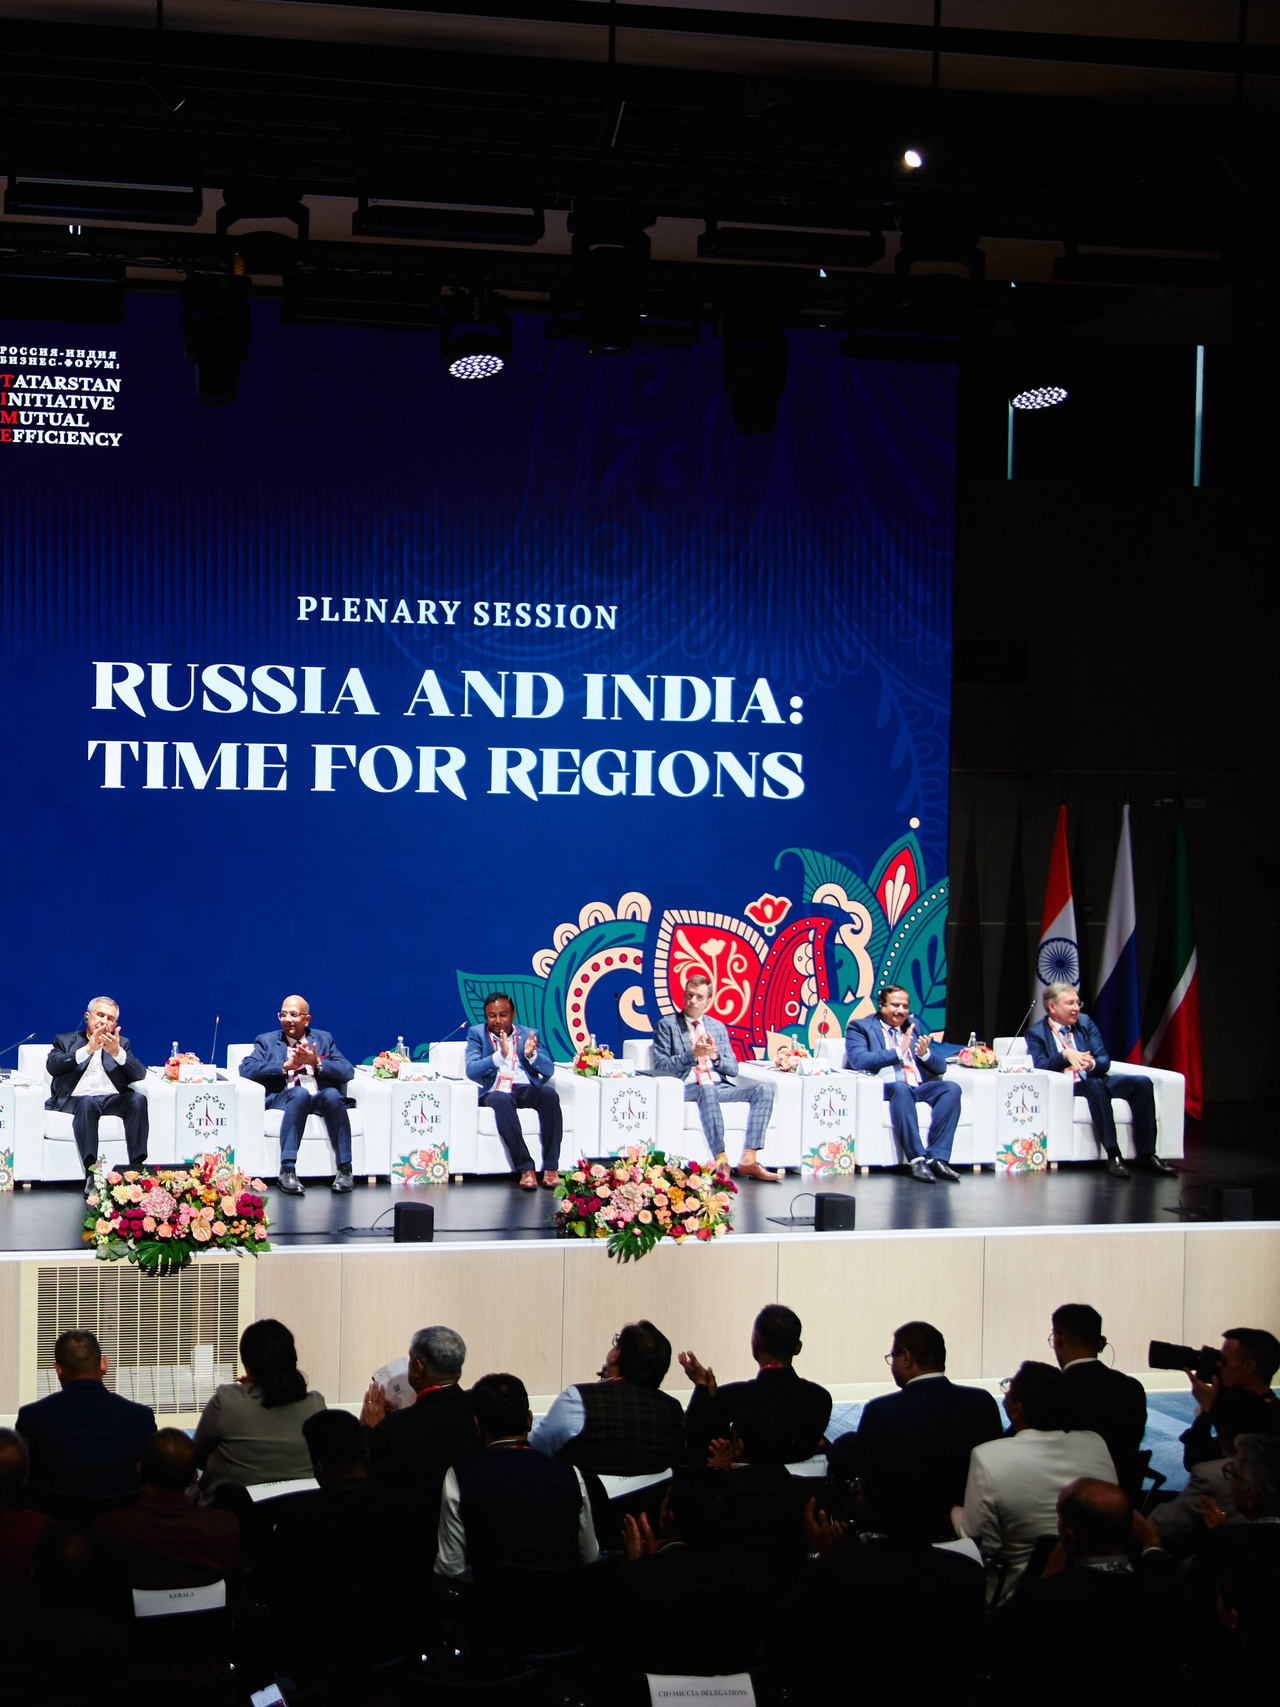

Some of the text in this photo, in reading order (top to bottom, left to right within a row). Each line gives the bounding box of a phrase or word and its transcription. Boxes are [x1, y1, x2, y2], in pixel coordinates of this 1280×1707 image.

[0, 346, 117, 360] РОССИЯ-ИНДИЯ
[0, 356, 120, 369] БИЗНЕС-ФОРУМ:
[0, 374, 122, 393] TATARSTAN
[0, 392, 115, 411] INITIATIVE
[0, 410, 90, 428] MUTUAL
[0, 428, 123, 447] EFFICIENCY
[297, 596, 618, 630] PLENARY SESSION
[91, 661, 804, 726] RUSSIA AND INDIA:
[87, 740, 806, 802] TIME FOR REGIONS
[620, 1111, 648, 1120] TIME
[821, 1108, 848, 1117] TIME
[1013, 1105, 1041, 1113] TIME
[196, 1117, 227, 1126] TIME
[411, 1115, 442, 1123] TIME
[168, 1591, 195, 1599] KERALA
[700, 1689, 748, 1697] DELEGATIONS
